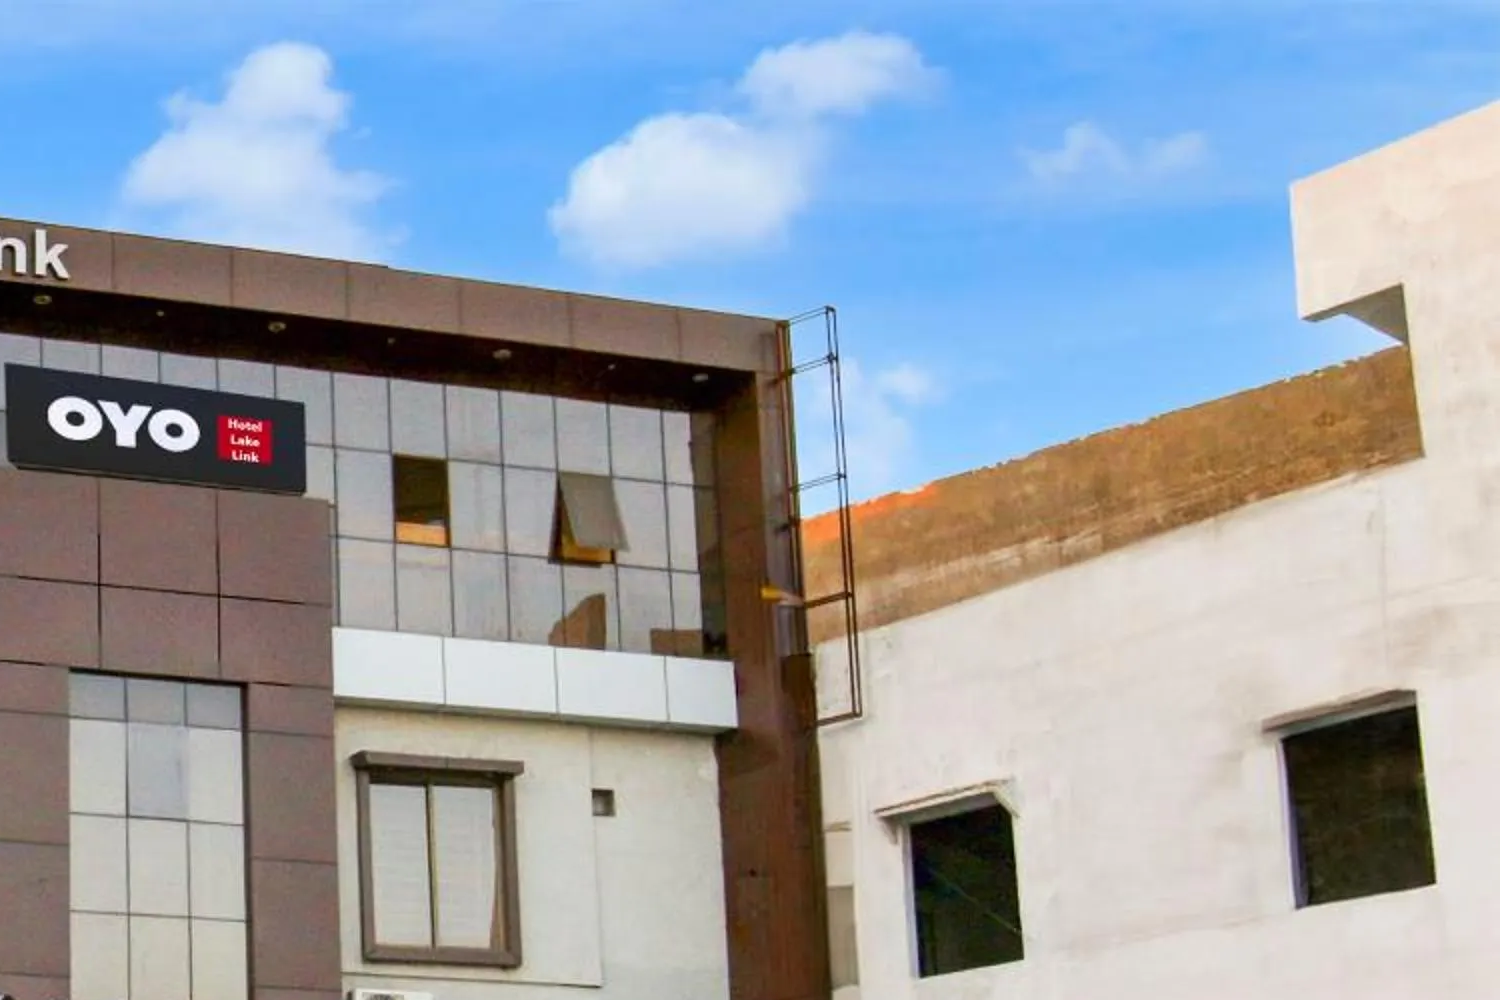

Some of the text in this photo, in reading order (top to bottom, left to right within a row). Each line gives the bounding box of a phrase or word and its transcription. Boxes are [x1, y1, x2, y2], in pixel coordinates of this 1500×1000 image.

[47, 395, 200, 452] OYO
[227, 418, 263, 432] Hotel
[230, 434, 260, 447] Lake
[231, 450, 260, 463] Link
